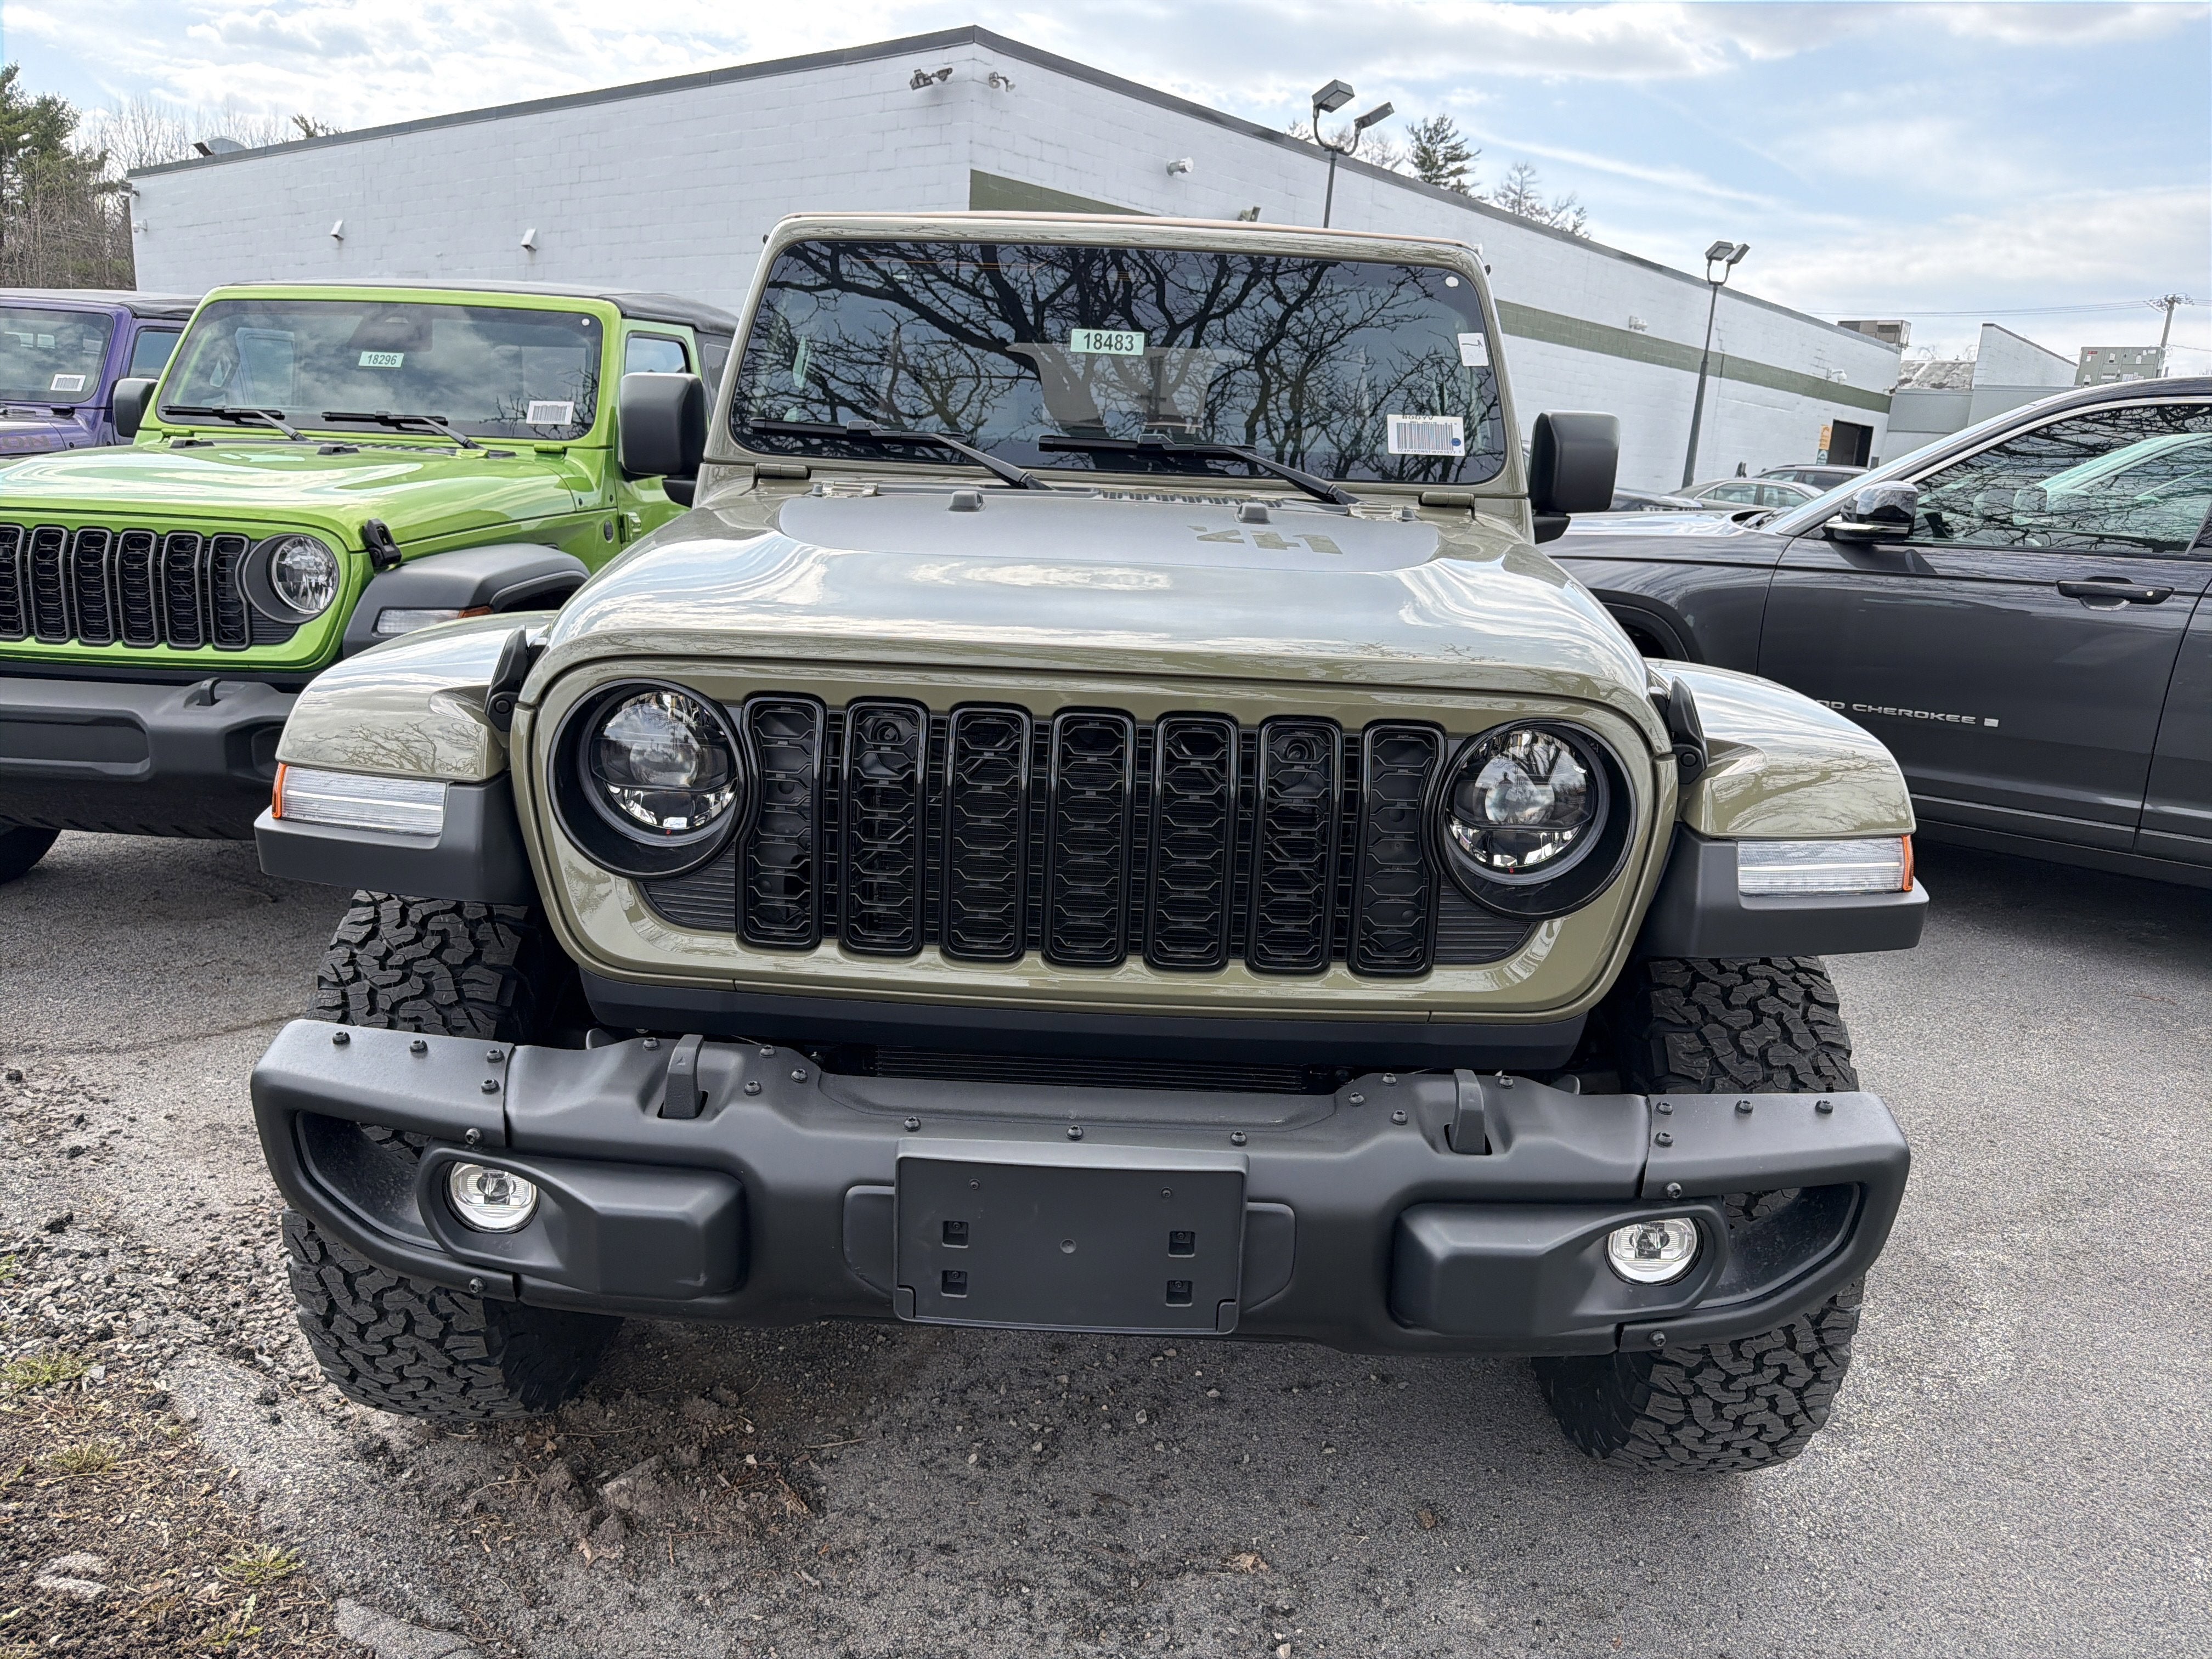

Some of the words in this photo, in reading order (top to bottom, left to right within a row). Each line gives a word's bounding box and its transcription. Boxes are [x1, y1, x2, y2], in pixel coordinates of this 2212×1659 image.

[1084, 332, 1134, 352] 18483
[368, 354, 398, 365] 18296
[1852, 703, 1977, 724] CHEROKEE
